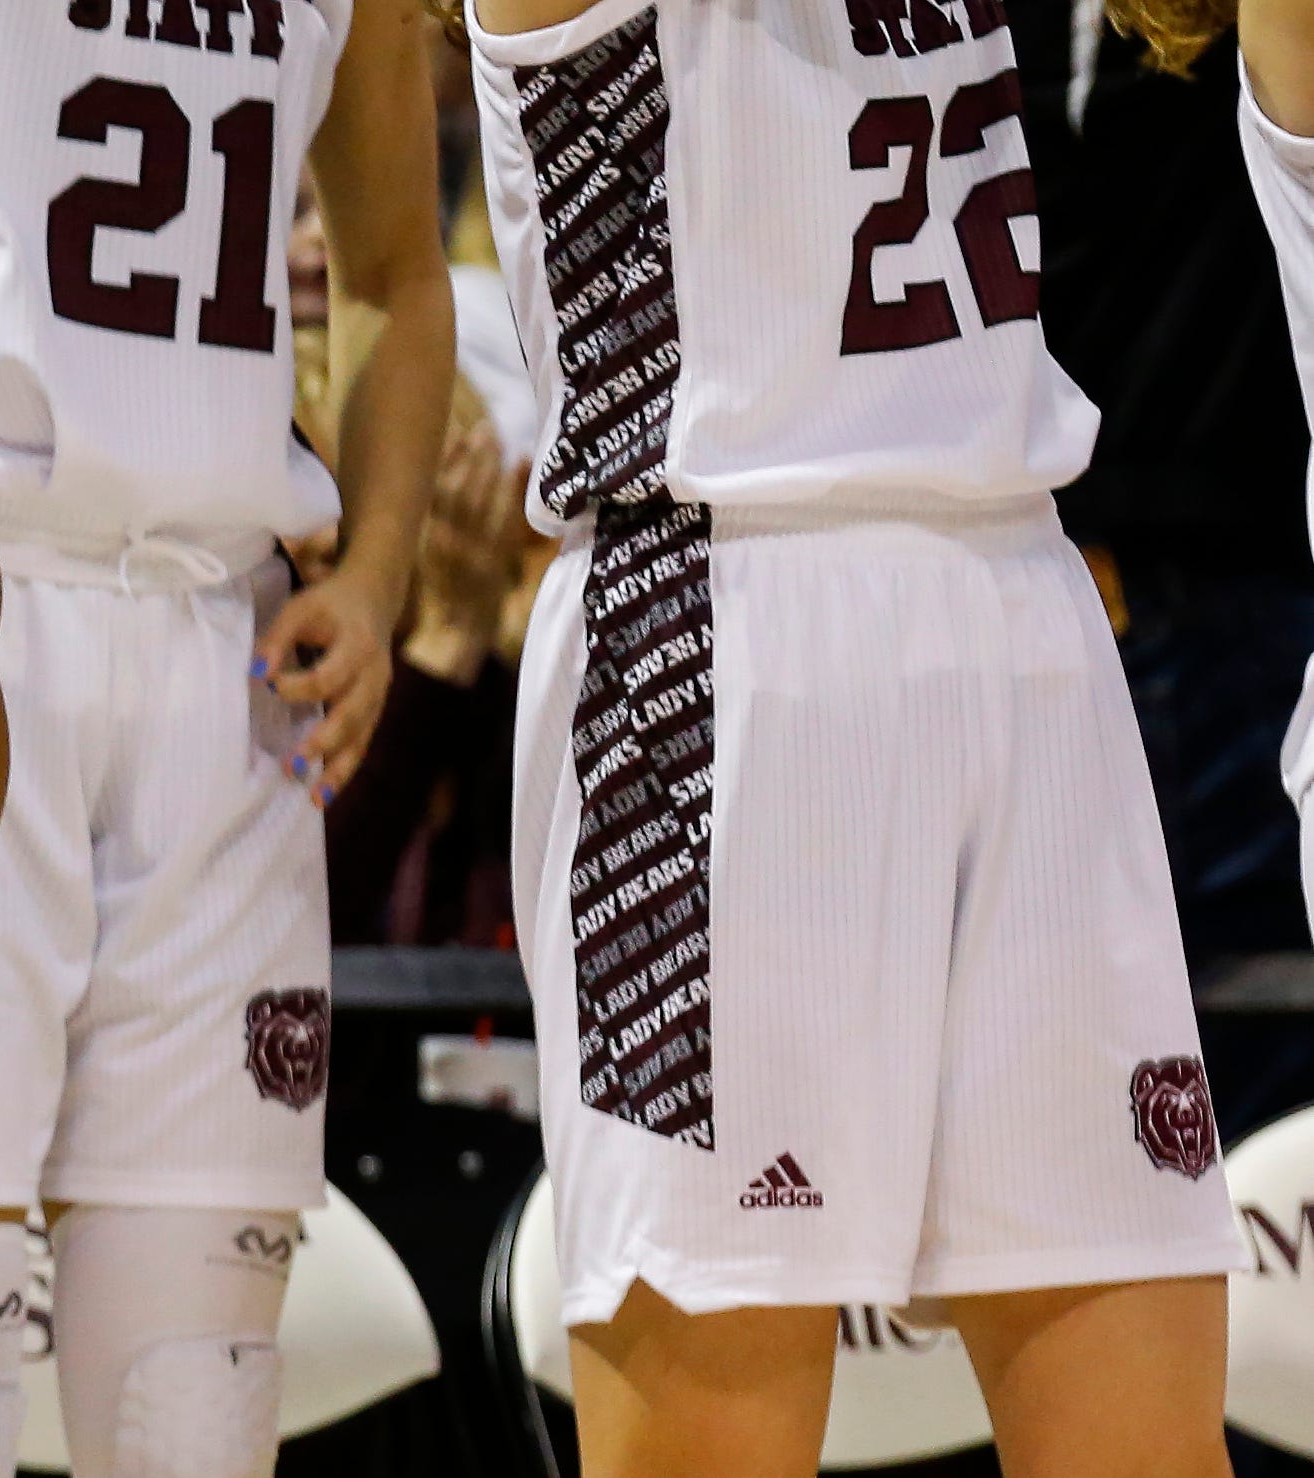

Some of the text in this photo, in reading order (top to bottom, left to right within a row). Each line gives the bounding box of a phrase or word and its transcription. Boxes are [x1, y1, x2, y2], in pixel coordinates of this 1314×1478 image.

[525, 92, 580, 151] EARS
[46, 75, 276, 354] 21
[840, 66, 1042, 357] 22
[630, 678, 698, 733] LADY
[600, 809, 681, 873] BEARS
[616, 847, 695, 913] BEARS
[593, 926, 711, 1024] LADY BEAR
[608, 1005, 662, 1062] LADY
[738, 1185, 824, 1209] adidas
